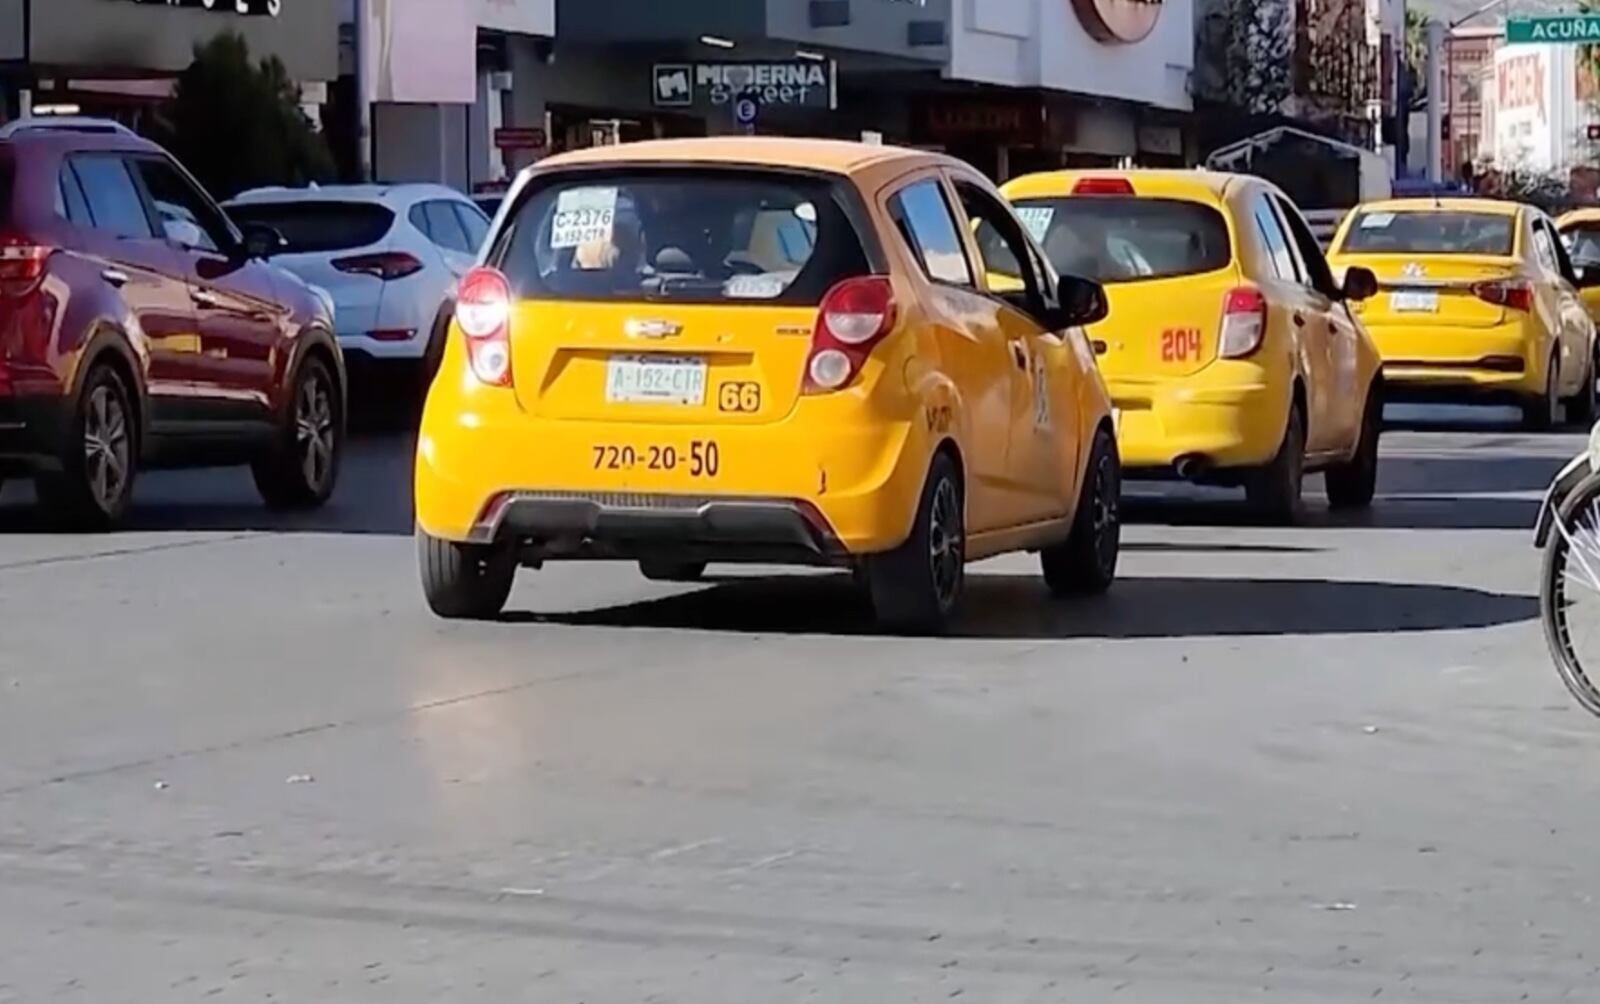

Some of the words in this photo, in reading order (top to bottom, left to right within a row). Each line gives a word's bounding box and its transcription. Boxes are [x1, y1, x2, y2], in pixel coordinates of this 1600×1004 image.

[1531, 18, 1600, 38] ACUÑA
[555, 209, 612, 228] C-2376
[1161, 328, 1202, 362] 204
[613, 367, 703, 391] A-152-CTR
[720, 383, 759, 411] 66
[592, 440, 719, 476] 720-20-50
